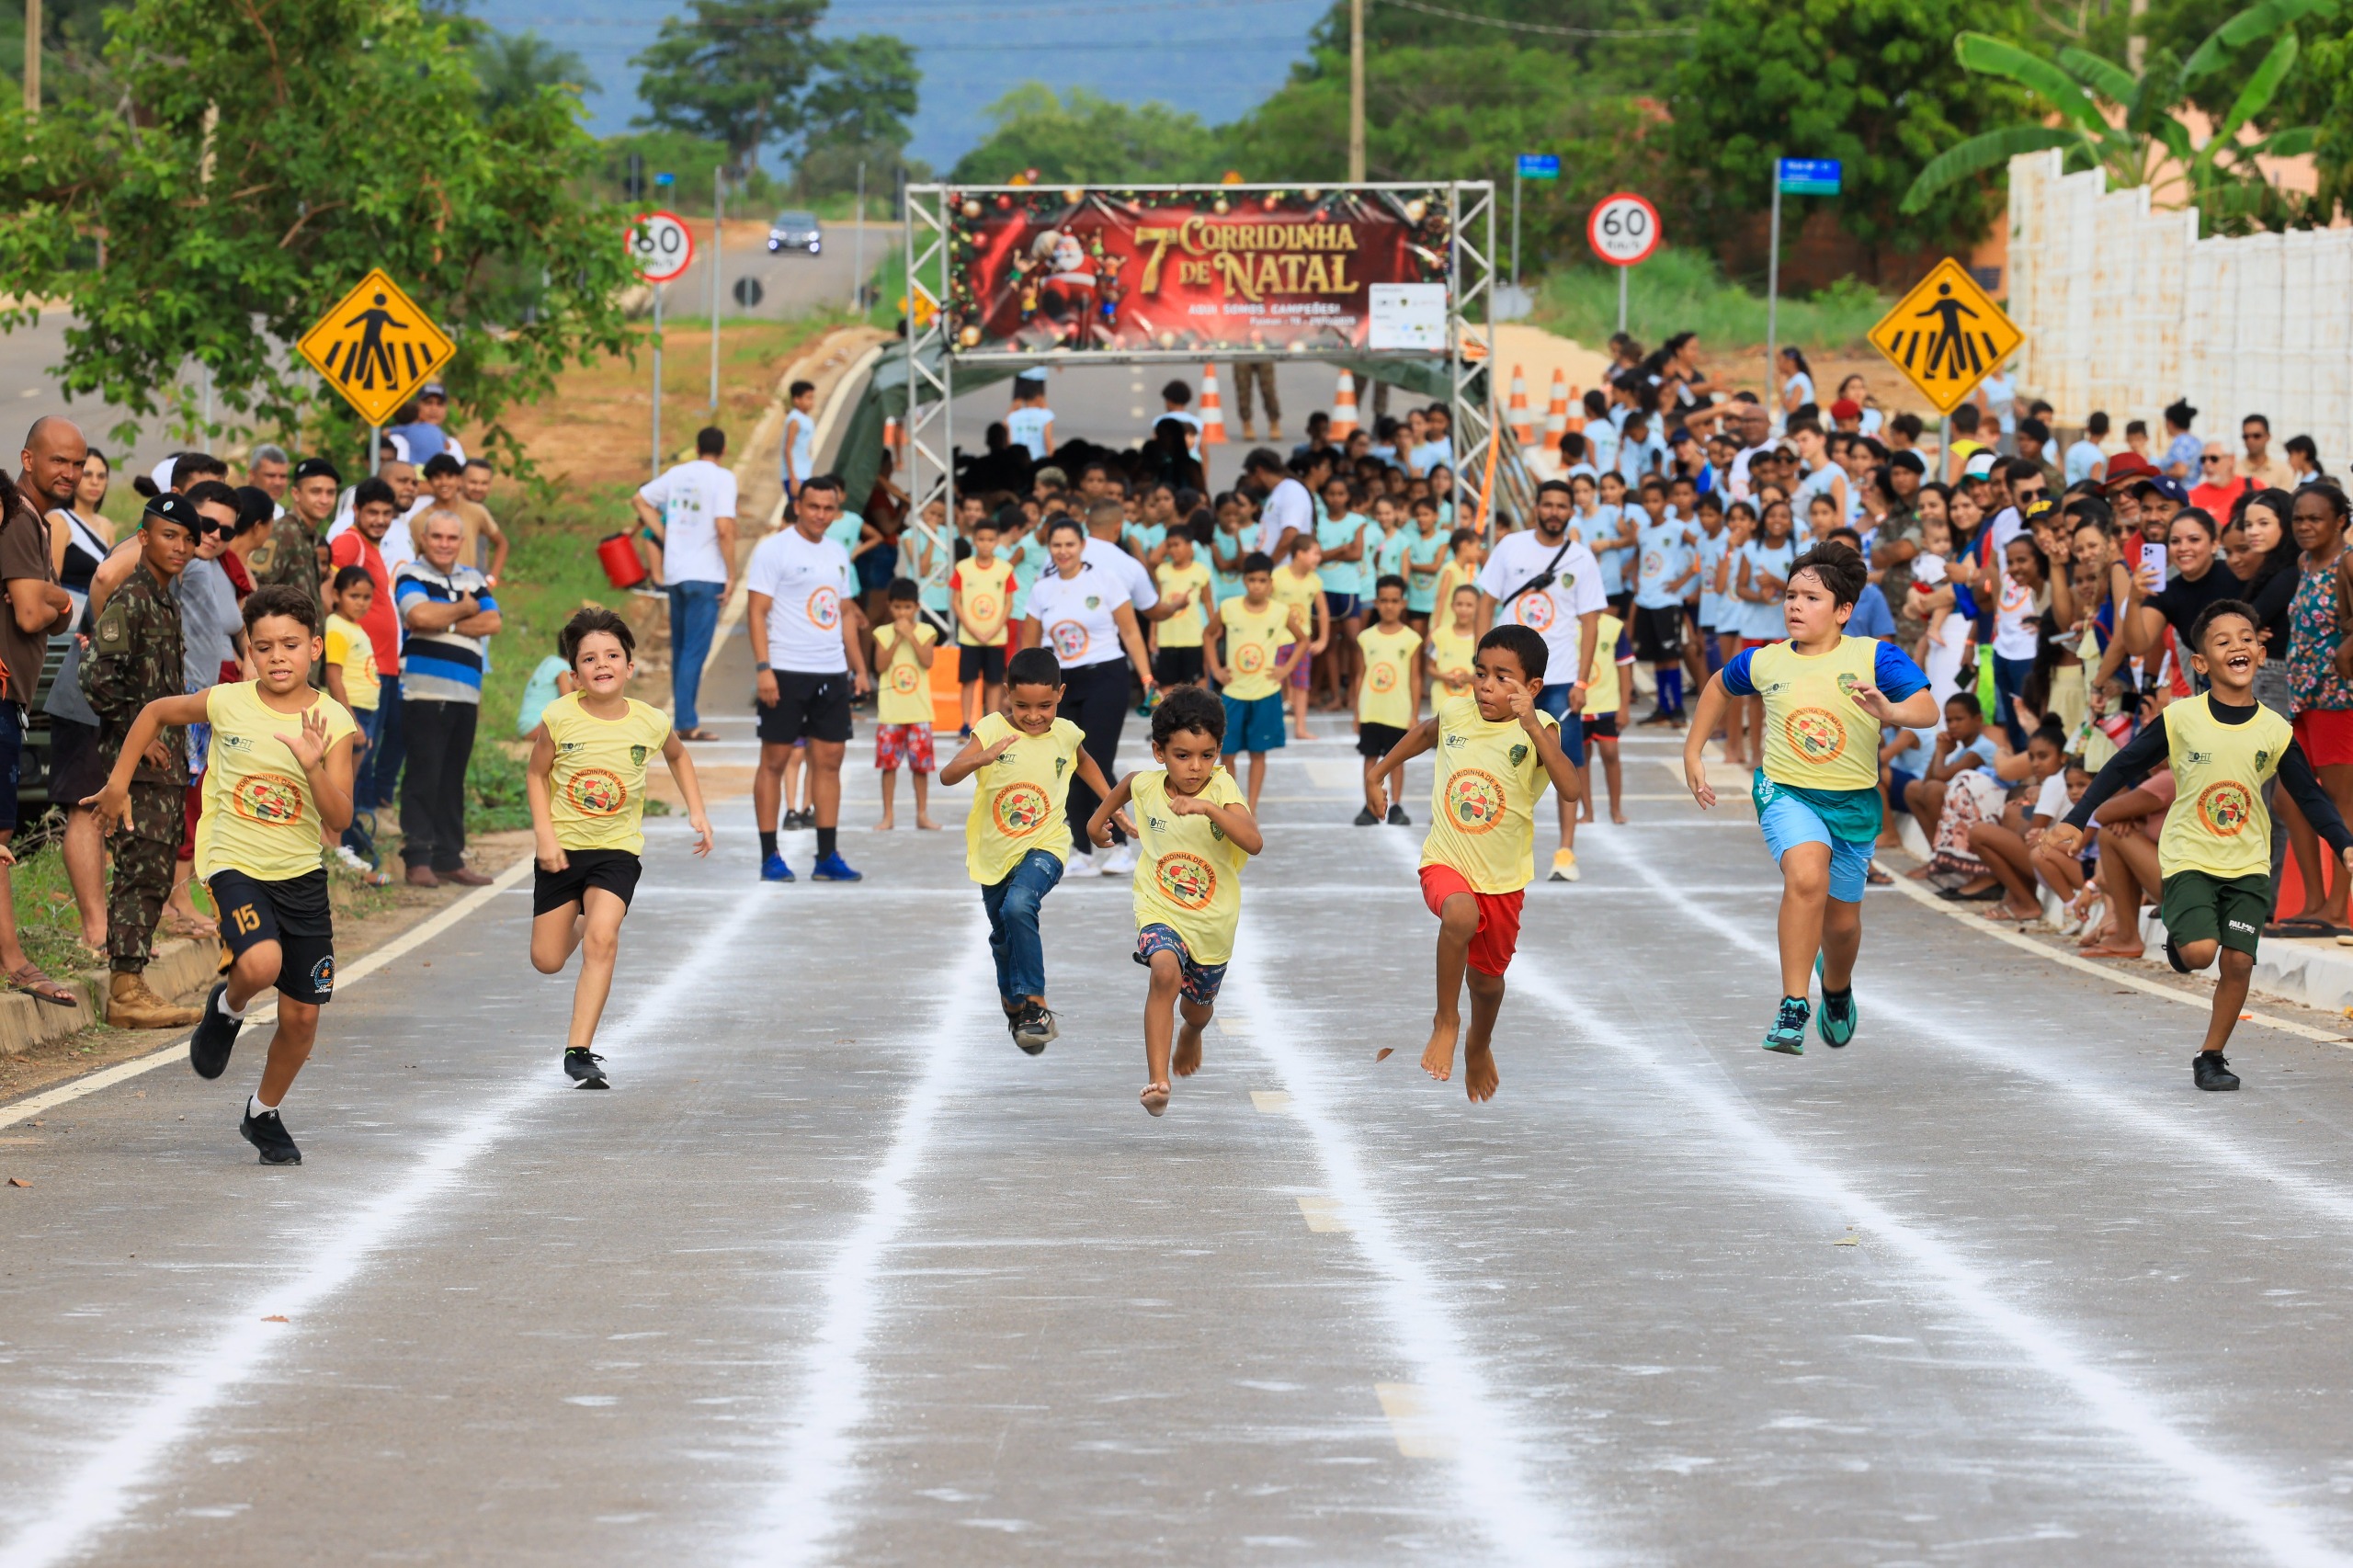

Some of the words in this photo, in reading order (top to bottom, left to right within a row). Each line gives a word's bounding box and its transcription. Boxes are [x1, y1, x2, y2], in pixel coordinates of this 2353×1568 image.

[1180, 215, 1358, 256] CORRIDINHA
[1604, 209, 1645, 235] 60
[1178, 260, 1211, 285] DE
[1212, 252, 1360, 302] NATAL
[1188, 303, 1218, 315] AQUI
[1222, 303, 1266, 315] SOMOS
[1270, 301, 1341, 315] CAMPEÕES!
[608, 773, 617, 782] DE
[998, 783, 1037, 799] CORRIDINHA
[1036, 788, 1045, 797] DE
[1484, 774, 1495, 785] DE
[1493, 783, 1506, 807] NATAL
[1192, 856, 1204, 866] DE
[1202, 863, 1215, 884] NATAL
[232, 903, 261, 936] 15
